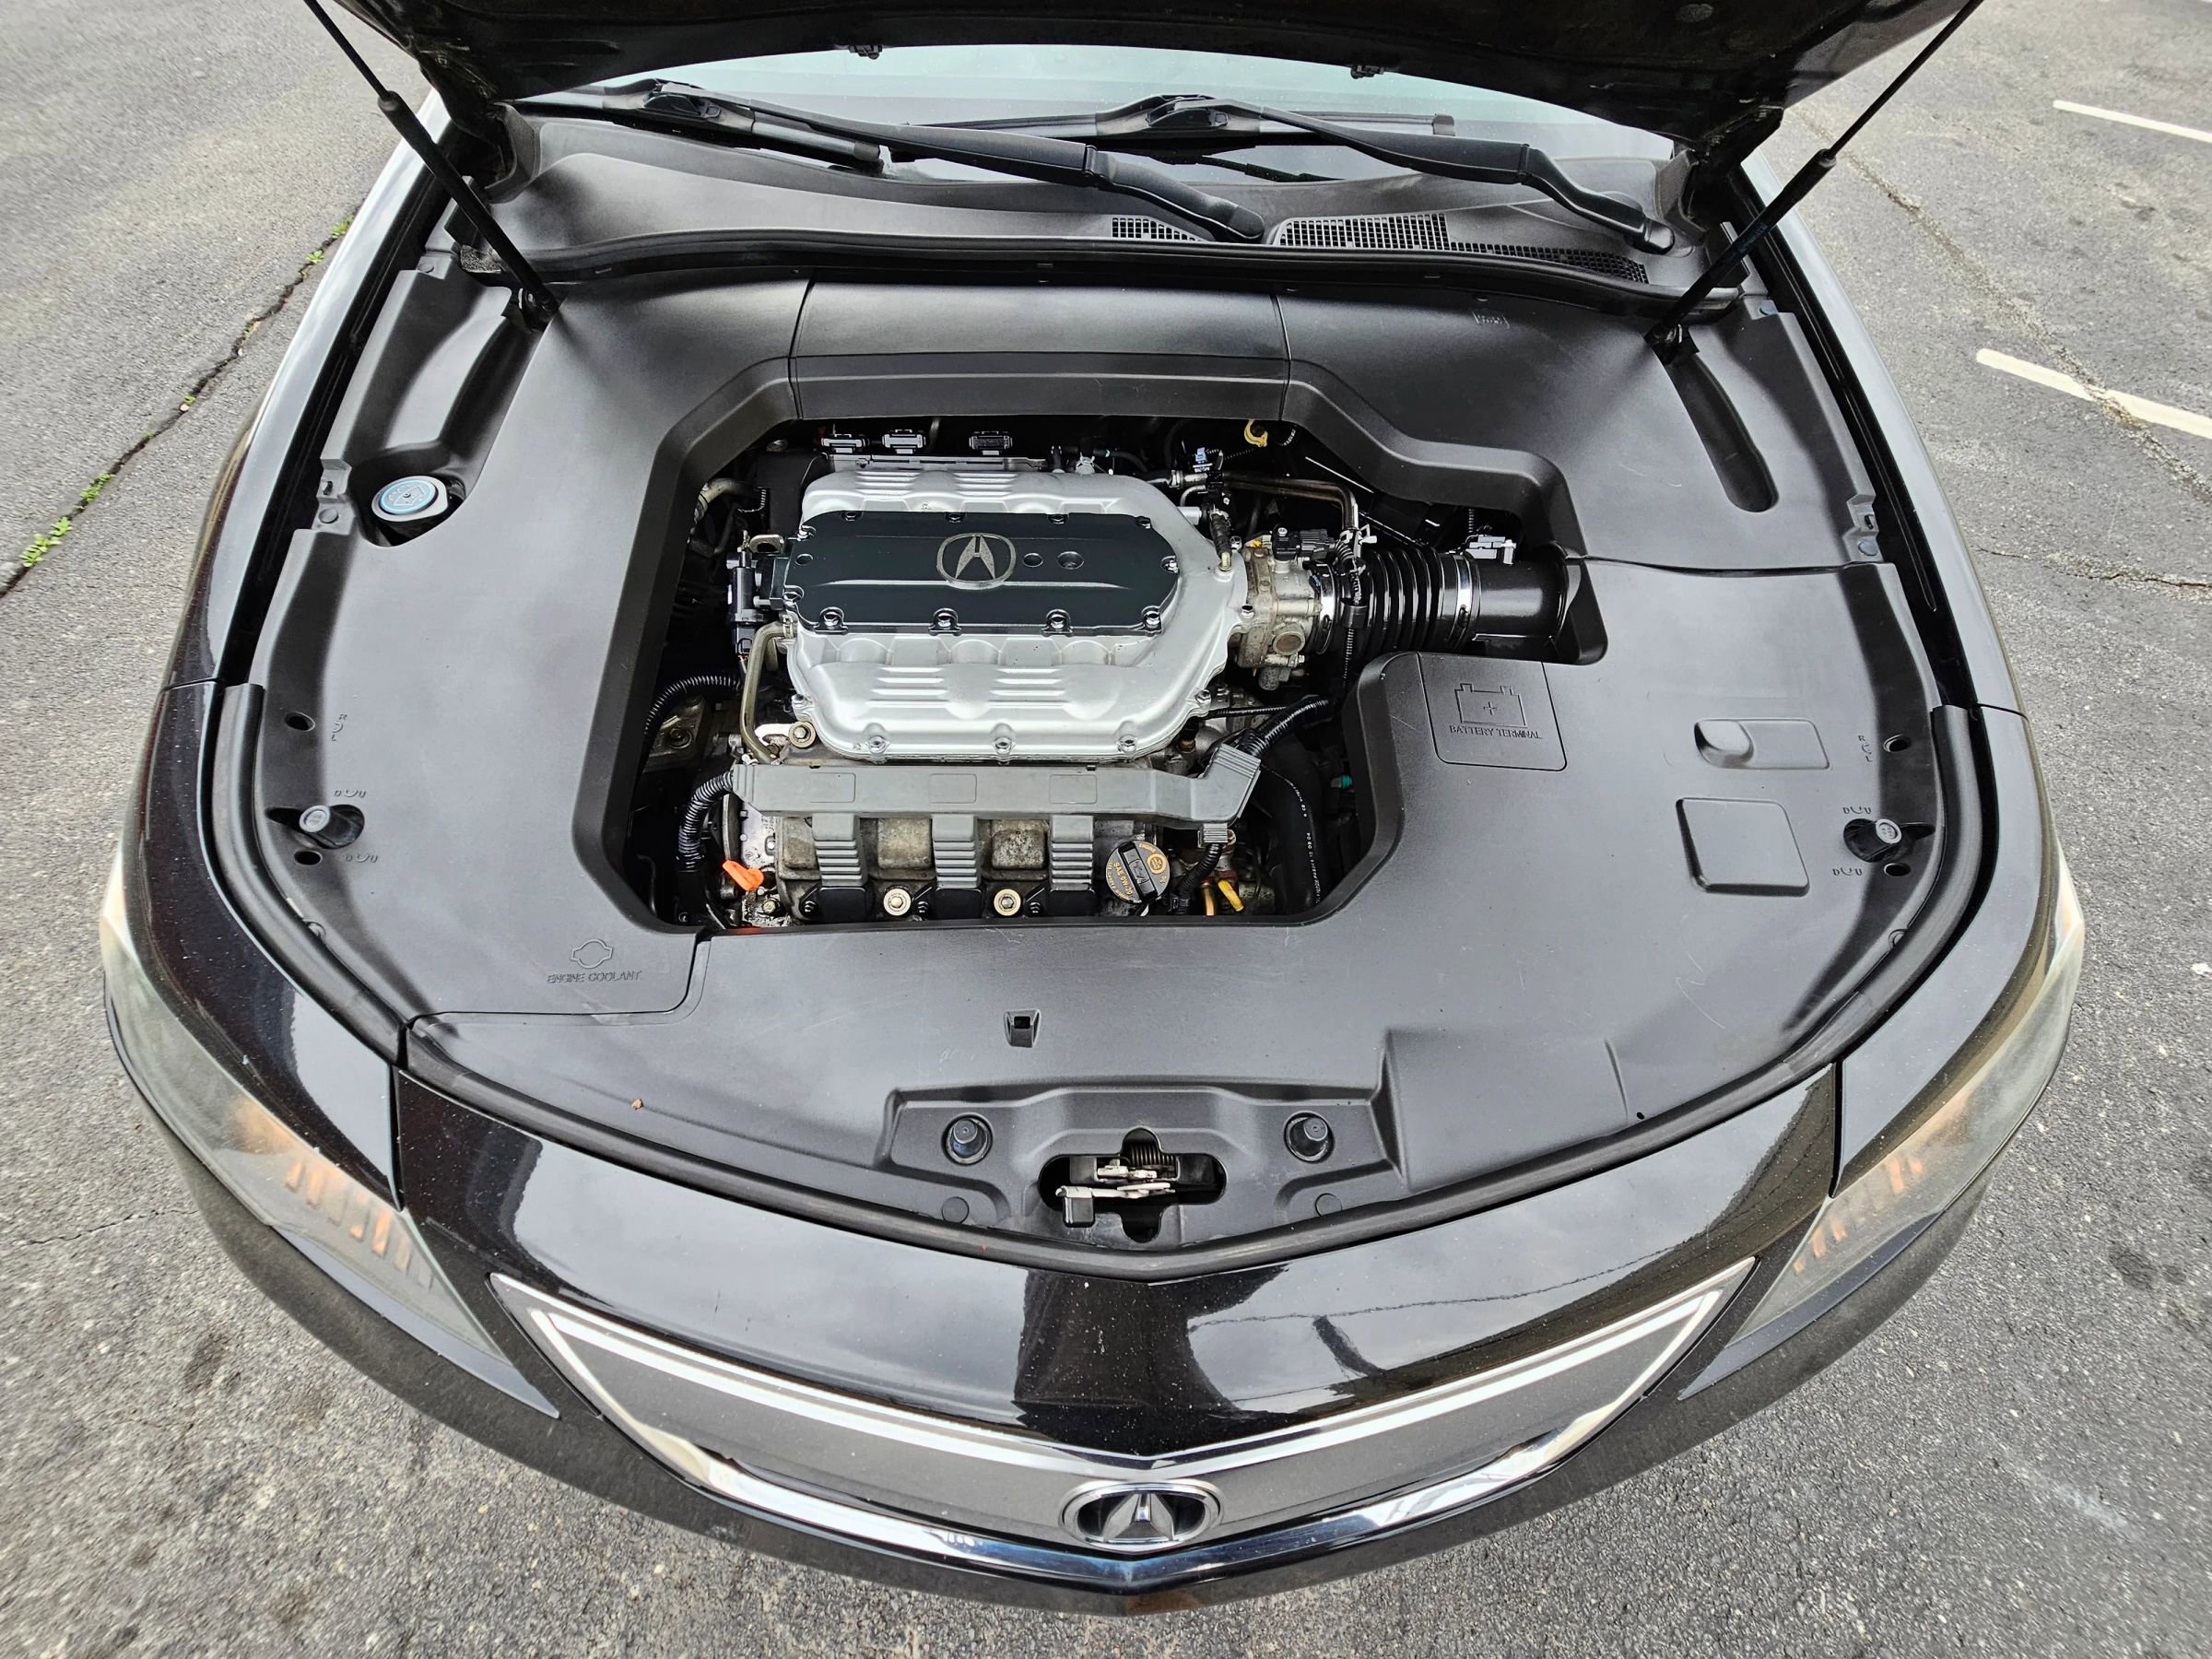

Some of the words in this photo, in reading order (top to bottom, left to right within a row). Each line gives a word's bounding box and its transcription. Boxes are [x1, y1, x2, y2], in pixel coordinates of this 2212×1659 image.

[1449, 724, 1494, 737] BATTERY
[1496, 727, 1544, 740] TERMINAL
[1113, 862, 1124, 877] SAE
[1120, 876, 1134, 896] 0W-20
[547, 972, 586, 984] ENGINE
[588, 970, 642, 982] COOLANT
